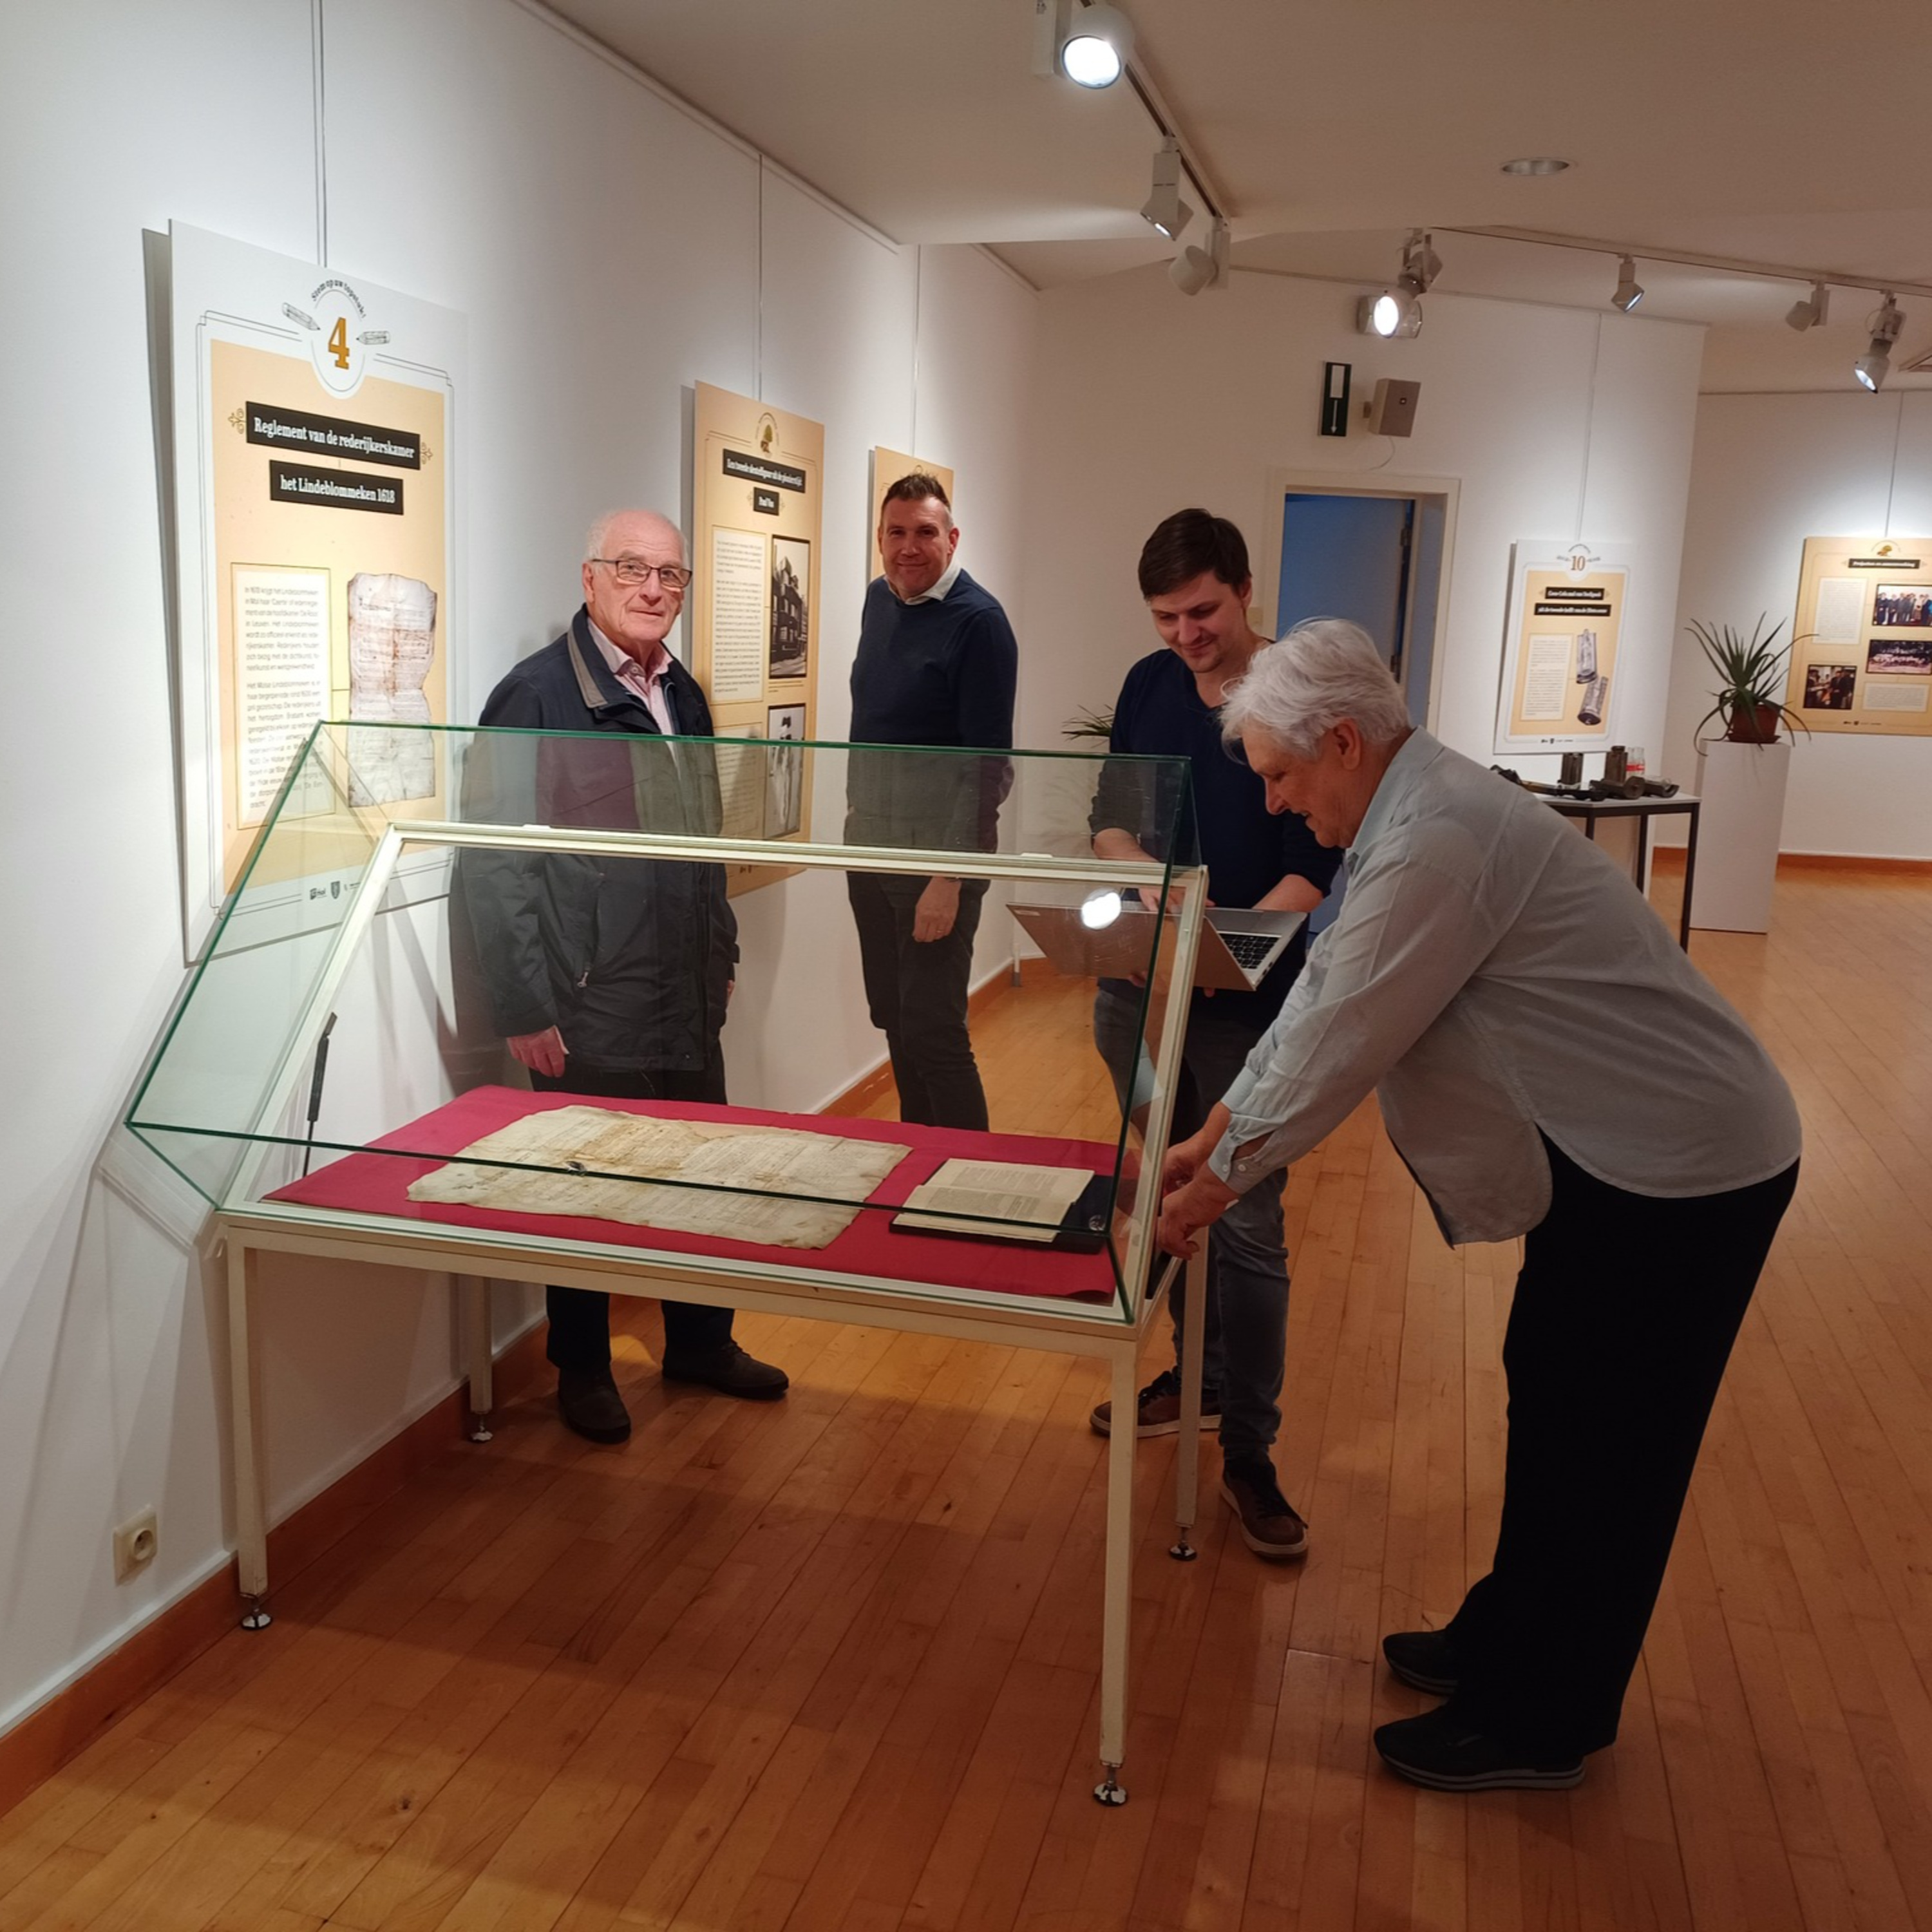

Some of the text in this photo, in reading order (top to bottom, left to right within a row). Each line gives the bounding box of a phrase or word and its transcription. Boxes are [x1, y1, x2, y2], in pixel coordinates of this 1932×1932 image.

[328, 317, 350, 370] 4
[254, 417, 415, 459] Reglement van de rederijkerskamer
[279, 474, 298, 491] het
[298, 477, 377, 501] Lindeblommeken
[1571, 555, 1586, 571] 10
